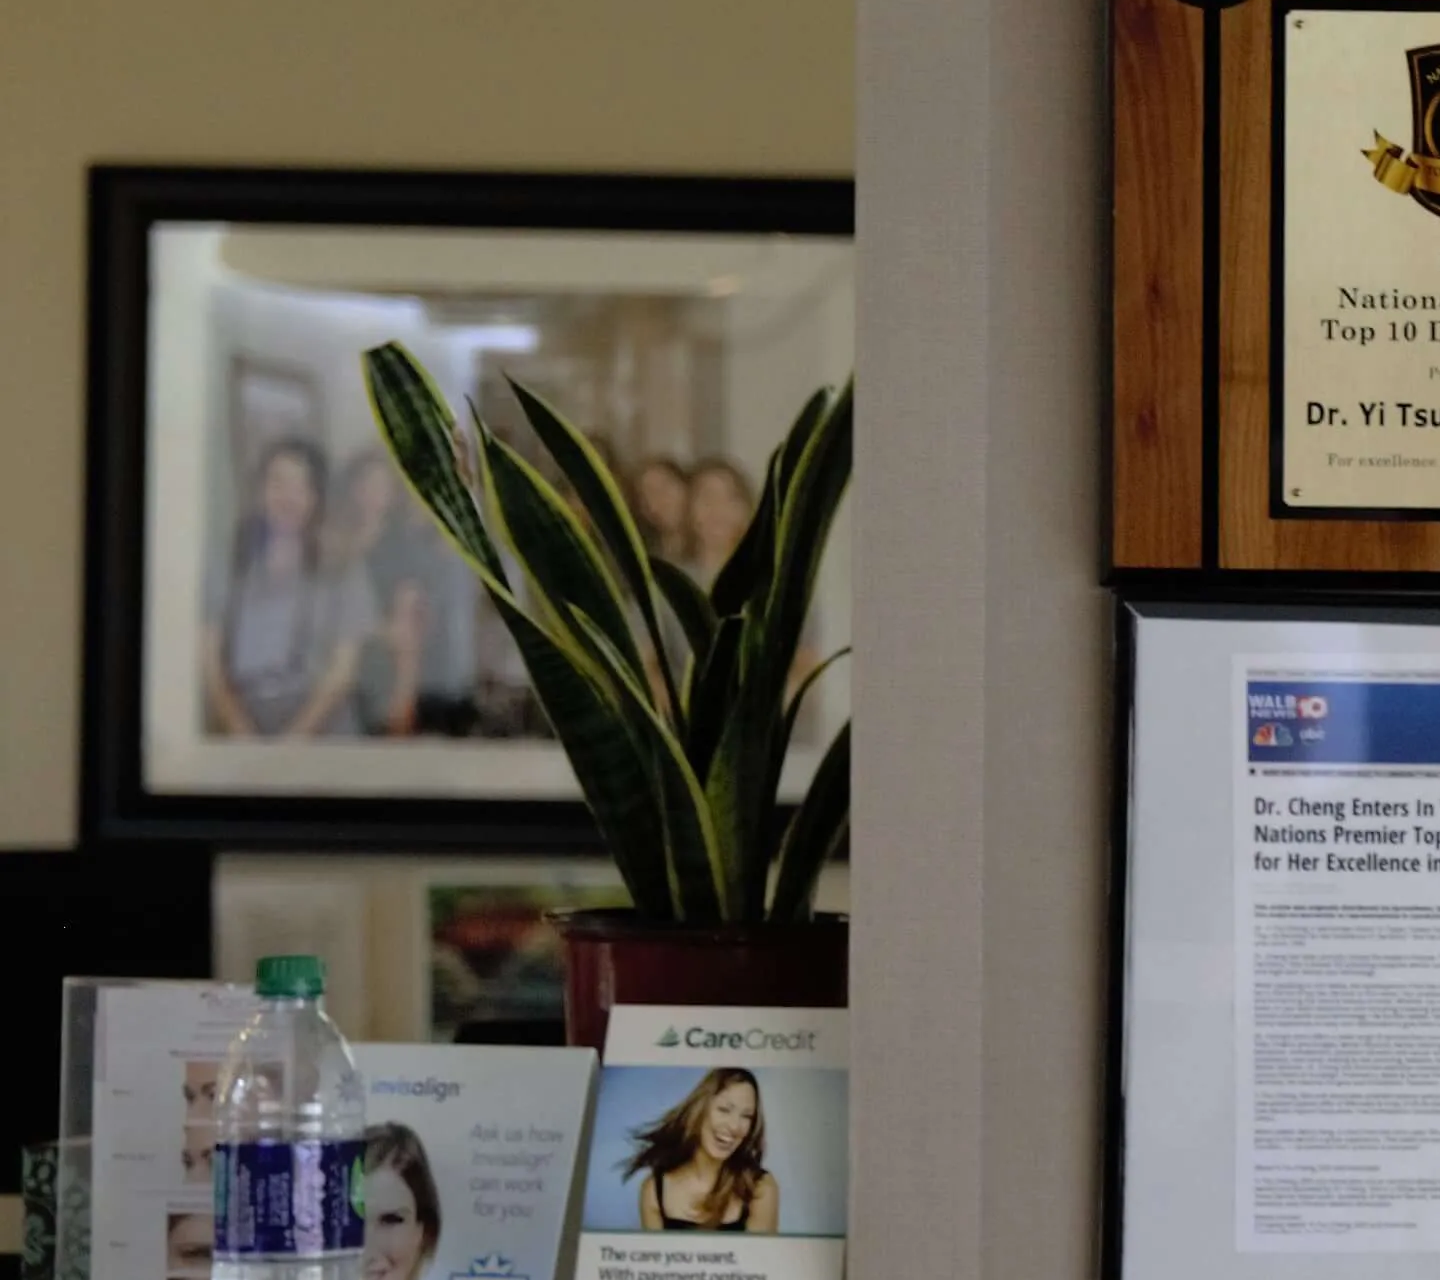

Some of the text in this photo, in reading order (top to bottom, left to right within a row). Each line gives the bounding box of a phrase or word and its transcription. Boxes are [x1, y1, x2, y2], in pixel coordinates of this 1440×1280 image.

[1320, 319, 1376, 346] Top
[1388, 321, 1417, 342] 10
[1306, 402, 1347, 426] Dr.
[1359, 403, 1385, 426] Yi
[1327, 453, 1352, 467] For
[1358, 453, 1436, 468] excellence
[1299, 694, 1327, 718] 10
[1254, 797, 1282, 816] Dr.
[1288, 798, 1345, 822] Cheng
[1352, 798, 1410, 817] Enters
[1417, 799, 1434, 817] In
[1254, 825, 1326, 844] Nations
[1334, 826, 1405, 845] Premier
[1254, 852, 1281, 871] for
[1288, 853, 1319, 872] Her
[1327, 853, 1420, 873] Excellence
[684, 1027, 817, 1051] CareCredit
[371, 1077, 461, 1102] invisalign
[600, 1247, 626, 1262] The
[630, 1250, 661, 1263] care
[664, 1250, 692, 1266] you
